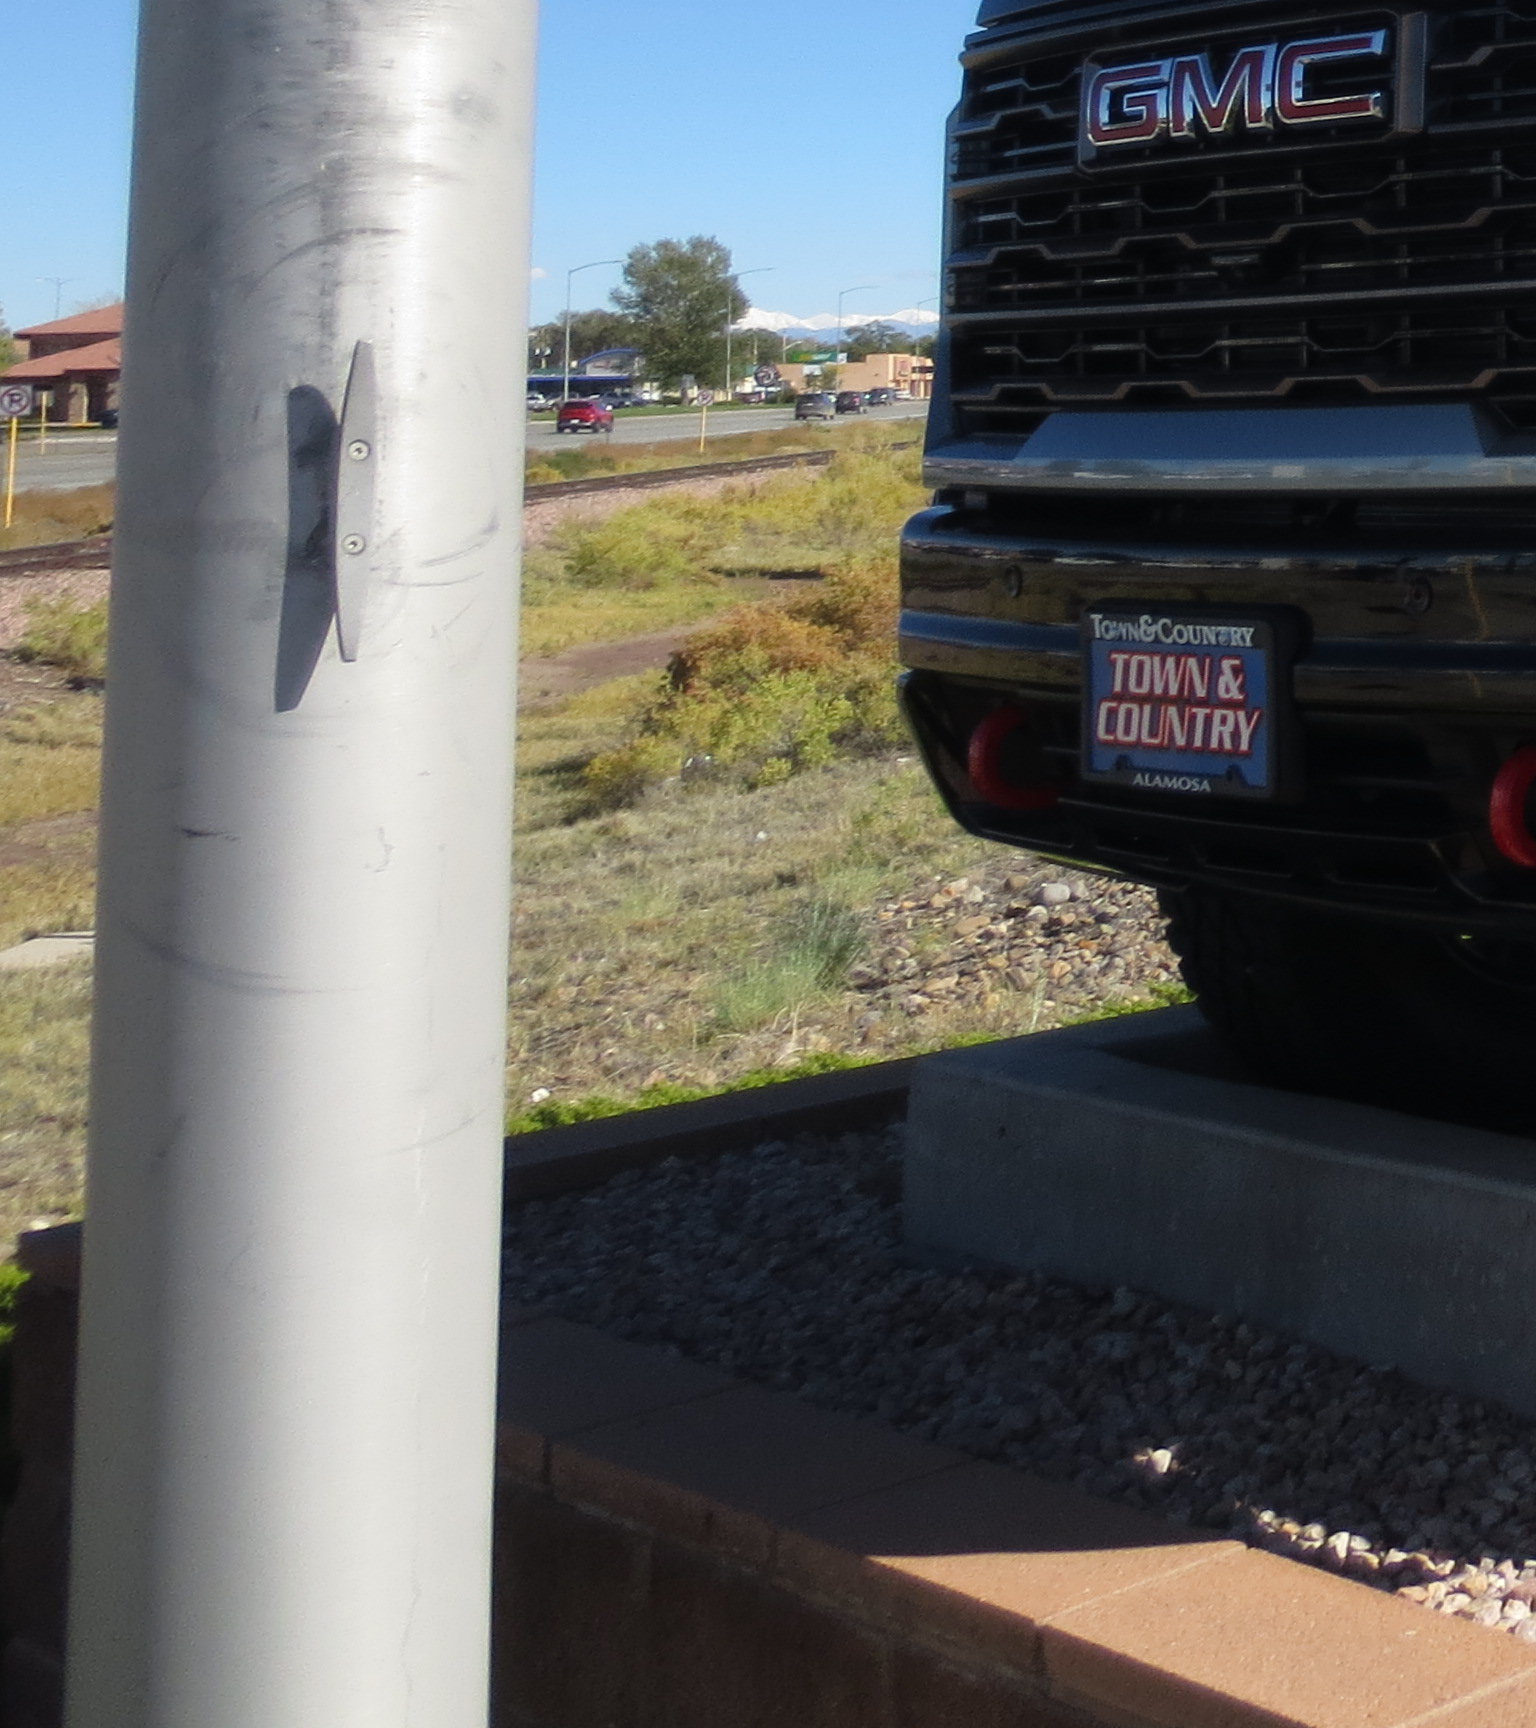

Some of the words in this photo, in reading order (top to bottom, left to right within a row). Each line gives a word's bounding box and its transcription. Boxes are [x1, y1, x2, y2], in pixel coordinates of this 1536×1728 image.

[1087, 28, 1388, 146] GMC
[1110, 650, 1211, 701] TOWN
[1216, 655, 1246, 702] &
[1096, 698, 1262, 755] COUNTRY
[1132, 772, 1212, 793] ALAMOSA
